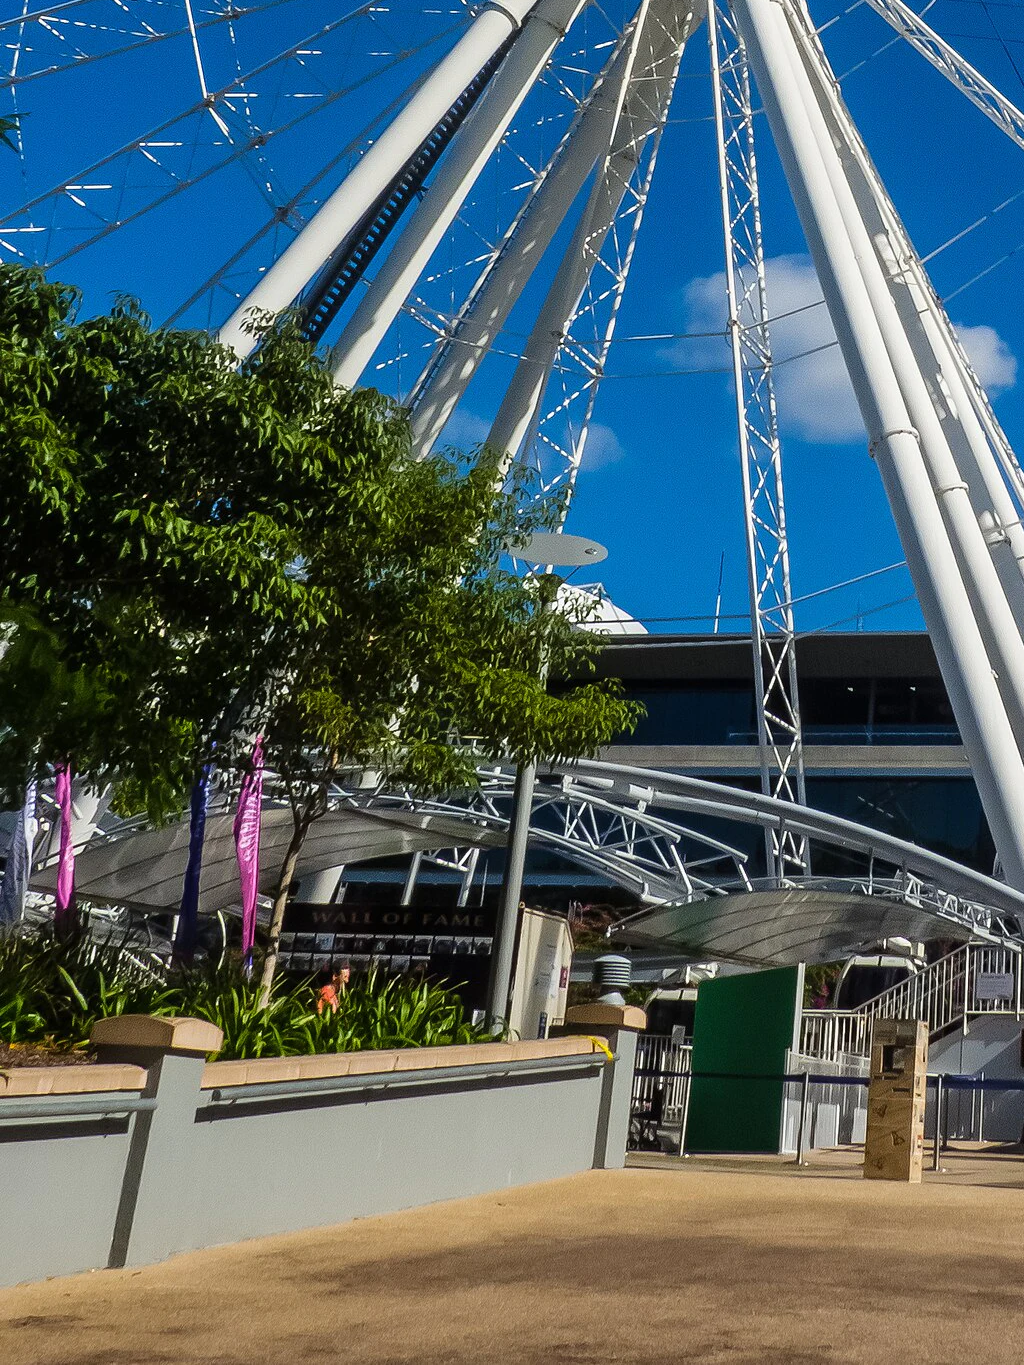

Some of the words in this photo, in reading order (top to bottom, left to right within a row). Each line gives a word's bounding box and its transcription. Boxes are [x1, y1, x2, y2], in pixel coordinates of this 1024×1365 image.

[312, 911, 374, 924] WALL
[382, 911, 414, 925] OF
[422, 912, 486, 927] FAME
